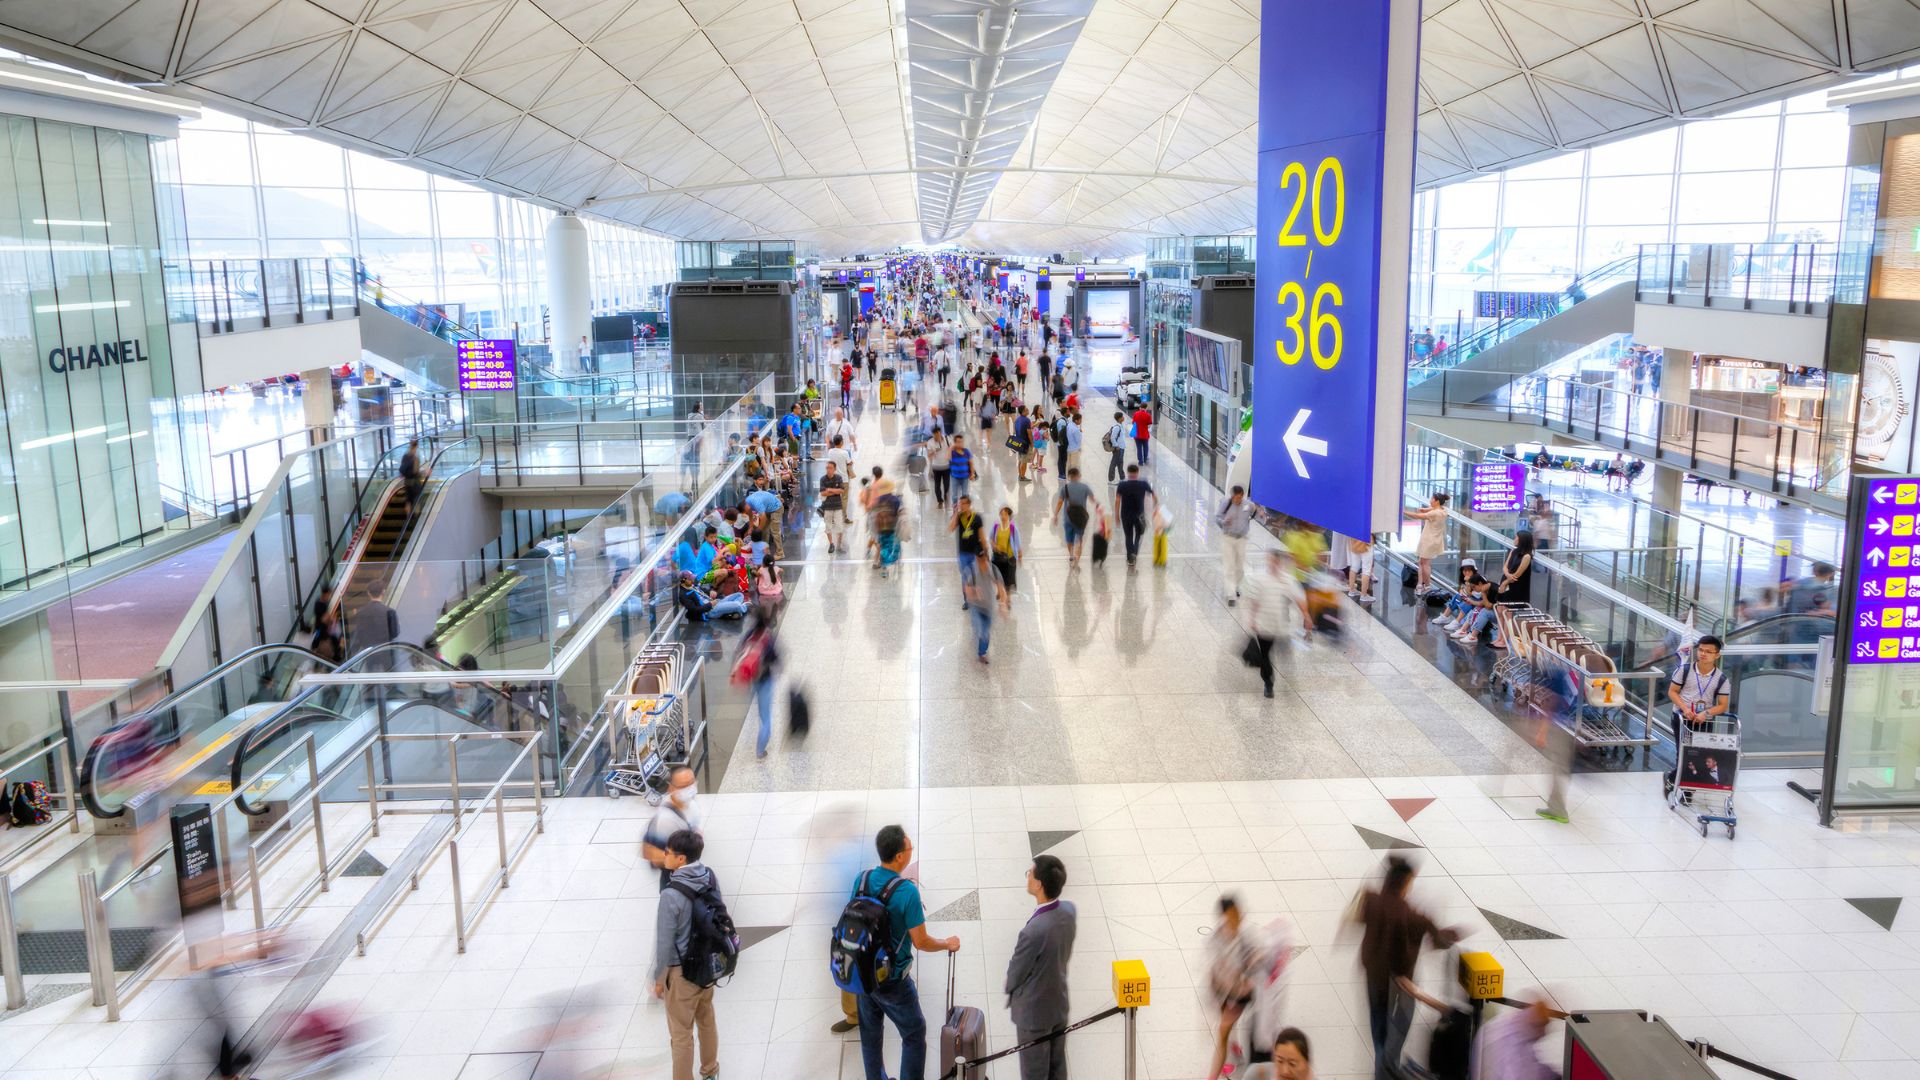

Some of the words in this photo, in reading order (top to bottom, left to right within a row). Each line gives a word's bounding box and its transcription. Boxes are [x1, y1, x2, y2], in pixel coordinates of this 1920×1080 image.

[1278, 156, 1345, 247] 20
[1276, 281, 1343, 370] 36
[484, 341, 495, 349] 1-4
[49, 339, 148, 373] CHANEL
[186, 850, 202, 859] Train
[187, 852, 209, 866] Service
[1477, 973, 1500, 986] 出口
[1123, 982, 1147, 994] 出口
[1479, 987, 1496, 995] Out
[1125, 994, 1142, 1003] Out
